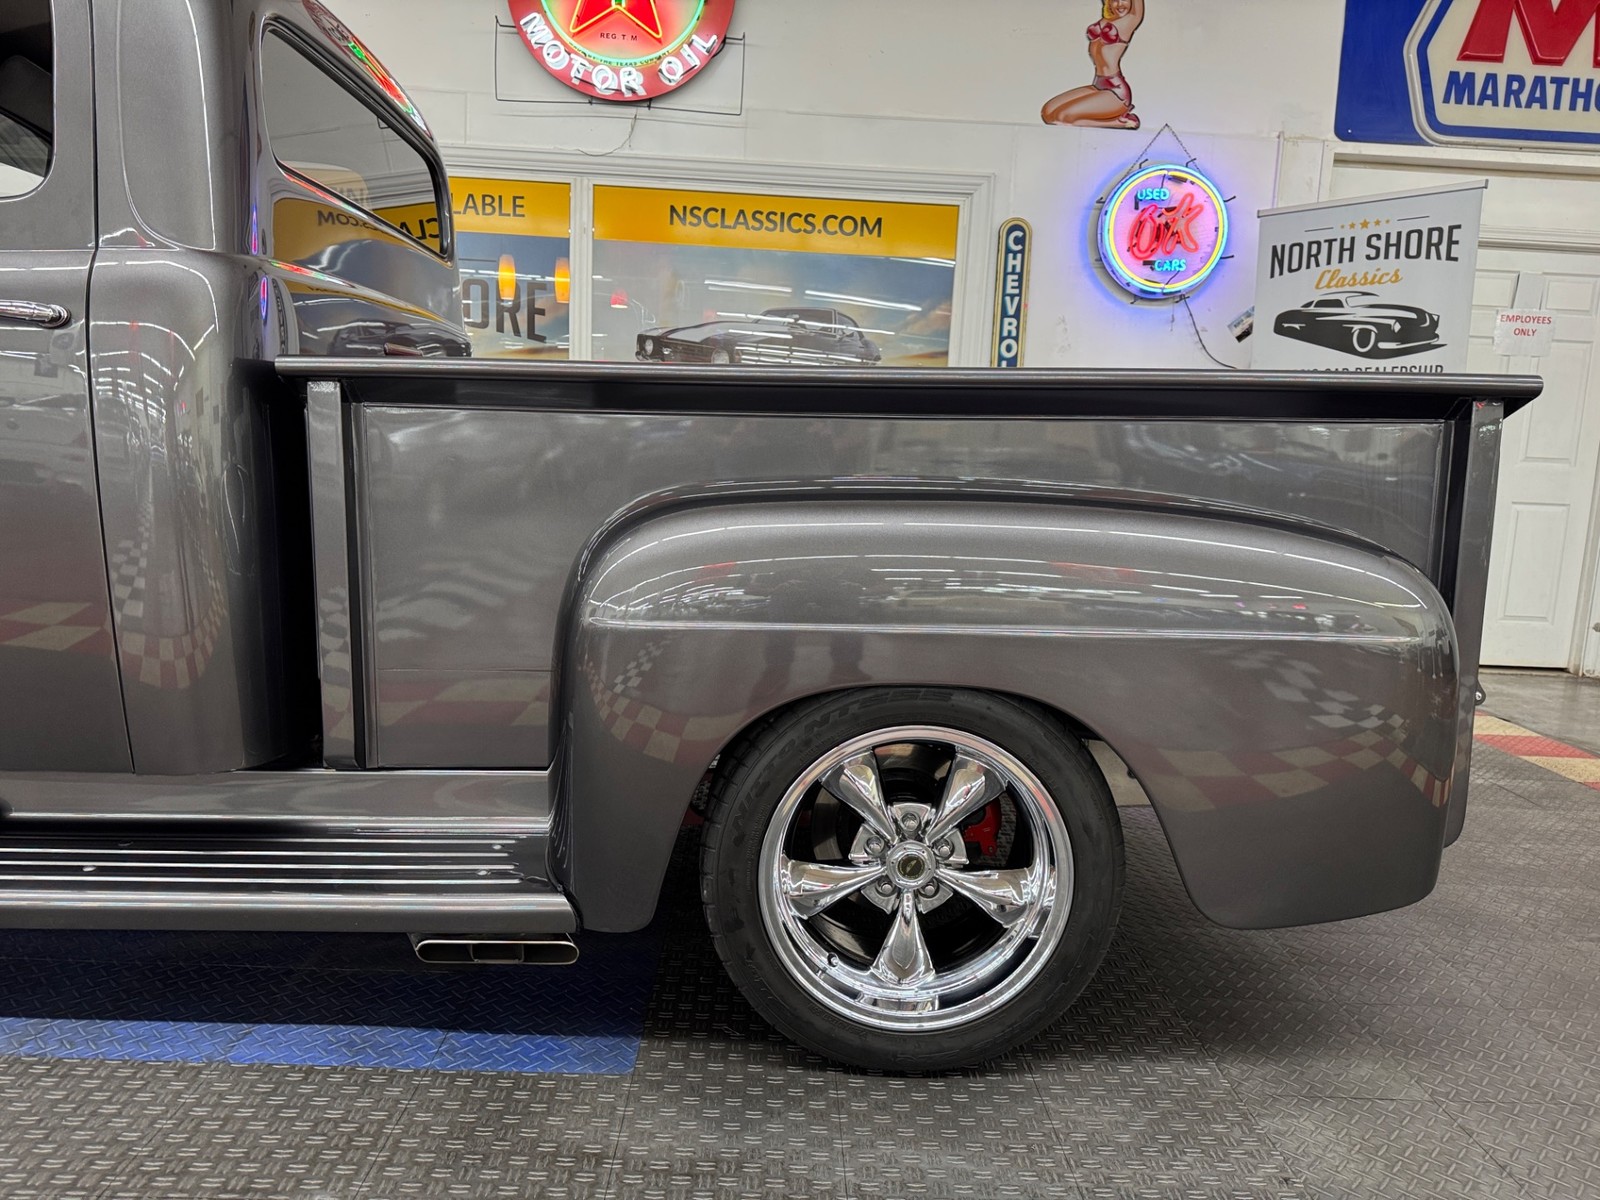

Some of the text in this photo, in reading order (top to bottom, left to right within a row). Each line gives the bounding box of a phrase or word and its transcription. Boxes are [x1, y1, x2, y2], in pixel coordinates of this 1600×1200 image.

[519, 12, 718, 97] MOTOR OIL
[1137, 188, 1170, 201] USED
[669, 205, 882, 238] NSCLASSICS.COM
[1129, 192, 1204, 260] OK
[1154, 259, 1187, 271] CARS
[1270, 224, 1462, 279] NORTH SHORE
[1314, 268, 1403, 290] Classics
[999, 230, 1024, 367] CHEVRO
[1500, 314, 1552, 324] EMPLOYEES
[1513, 328, 1537, 336] ONLY
